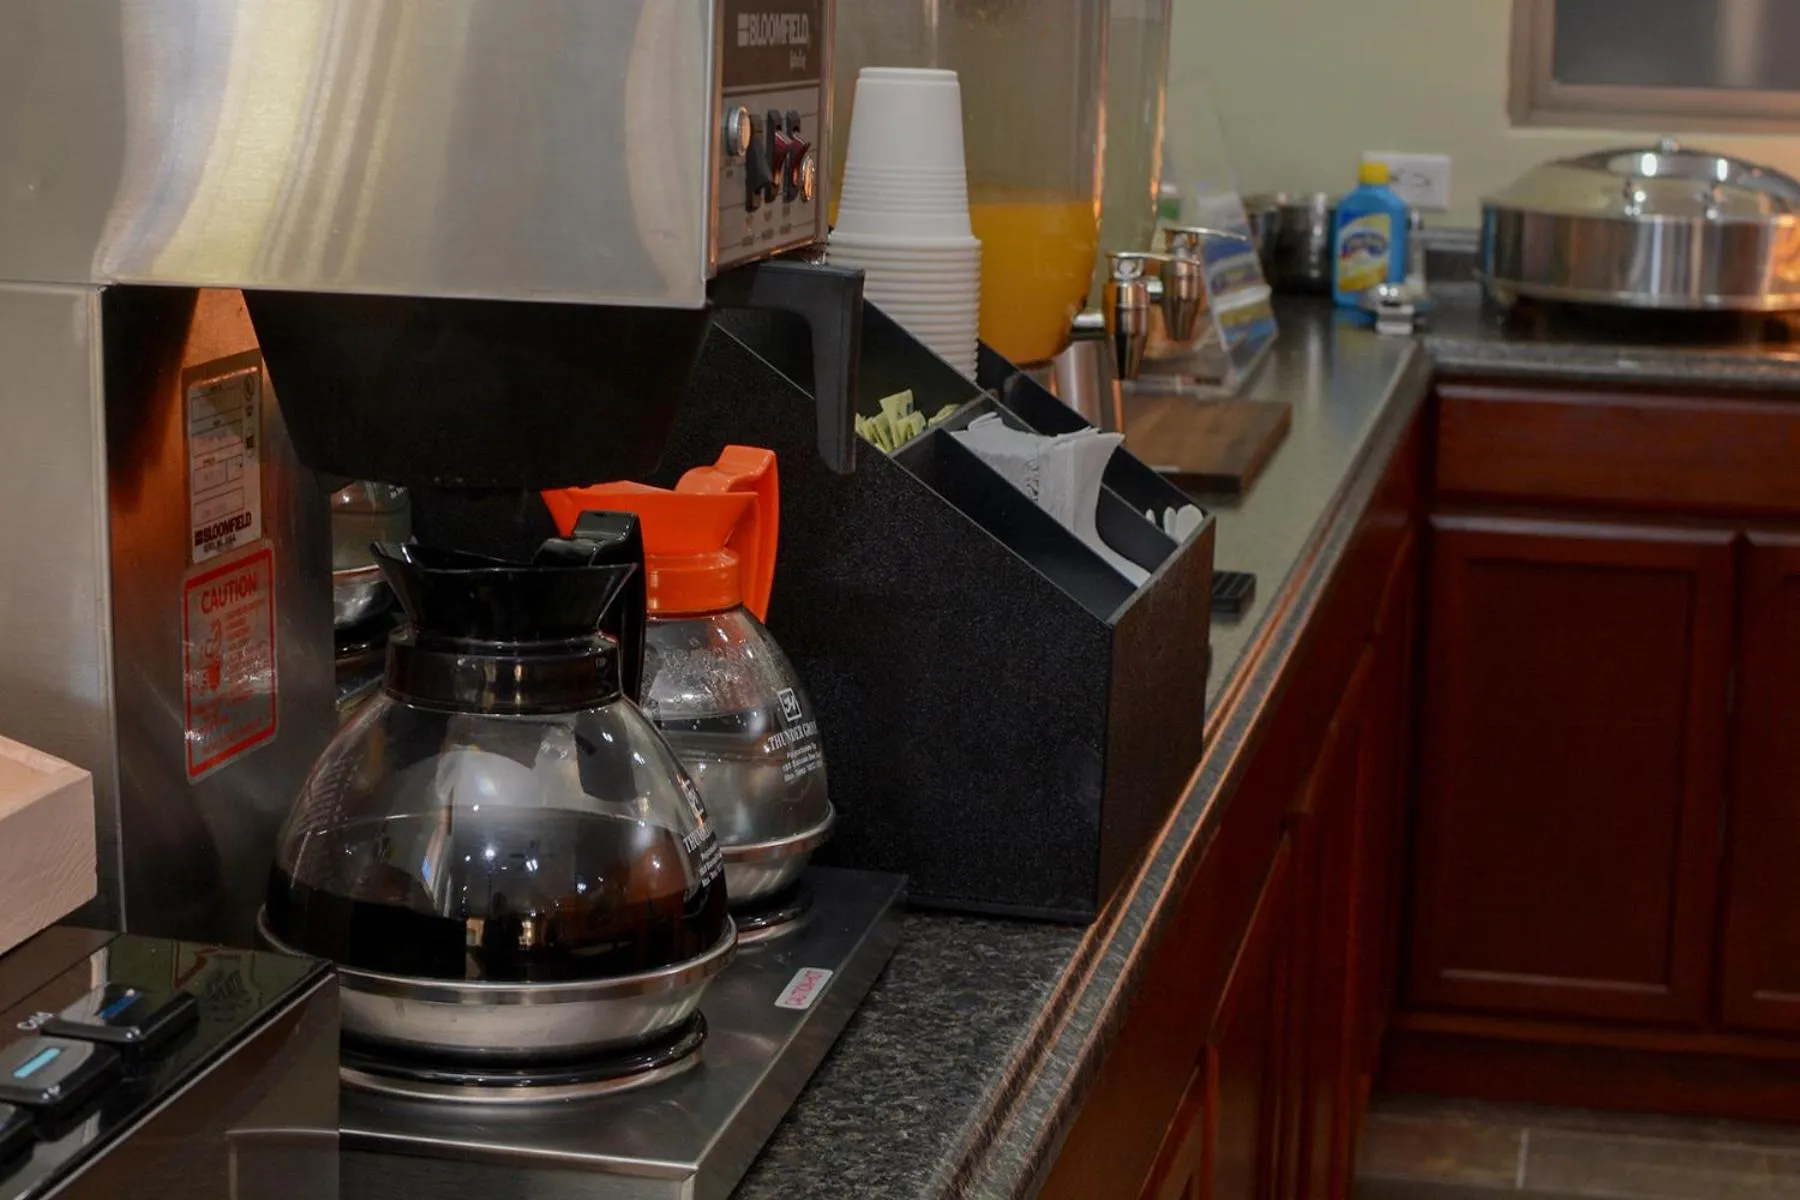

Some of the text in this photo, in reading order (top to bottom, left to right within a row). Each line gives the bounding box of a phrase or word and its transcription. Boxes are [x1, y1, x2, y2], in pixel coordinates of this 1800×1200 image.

[749, 13, 809, 46] BLOOMFIELD
[203, 512, 252, 543] BLOOMFIELD
[201, 573, 258, 614] CAUTION
